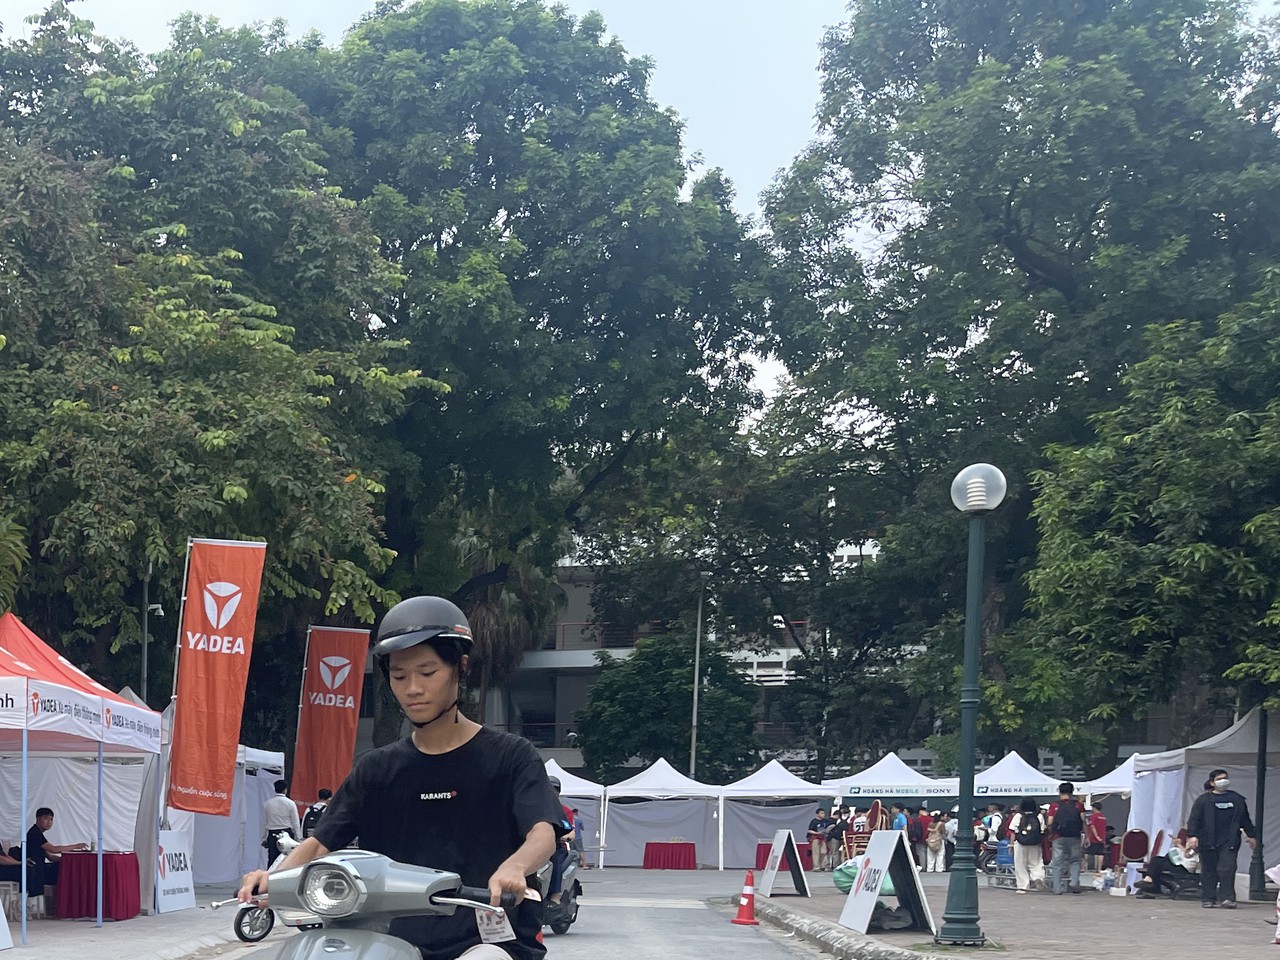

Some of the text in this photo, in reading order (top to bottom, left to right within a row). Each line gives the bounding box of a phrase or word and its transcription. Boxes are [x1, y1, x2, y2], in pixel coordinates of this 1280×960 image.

[186, 631, 245, 655] YADEA
[40, 698, 57, 713] YADEA
[308, 692, 355, 709] YADEA
[165, 852, 189, 872] YADEA
